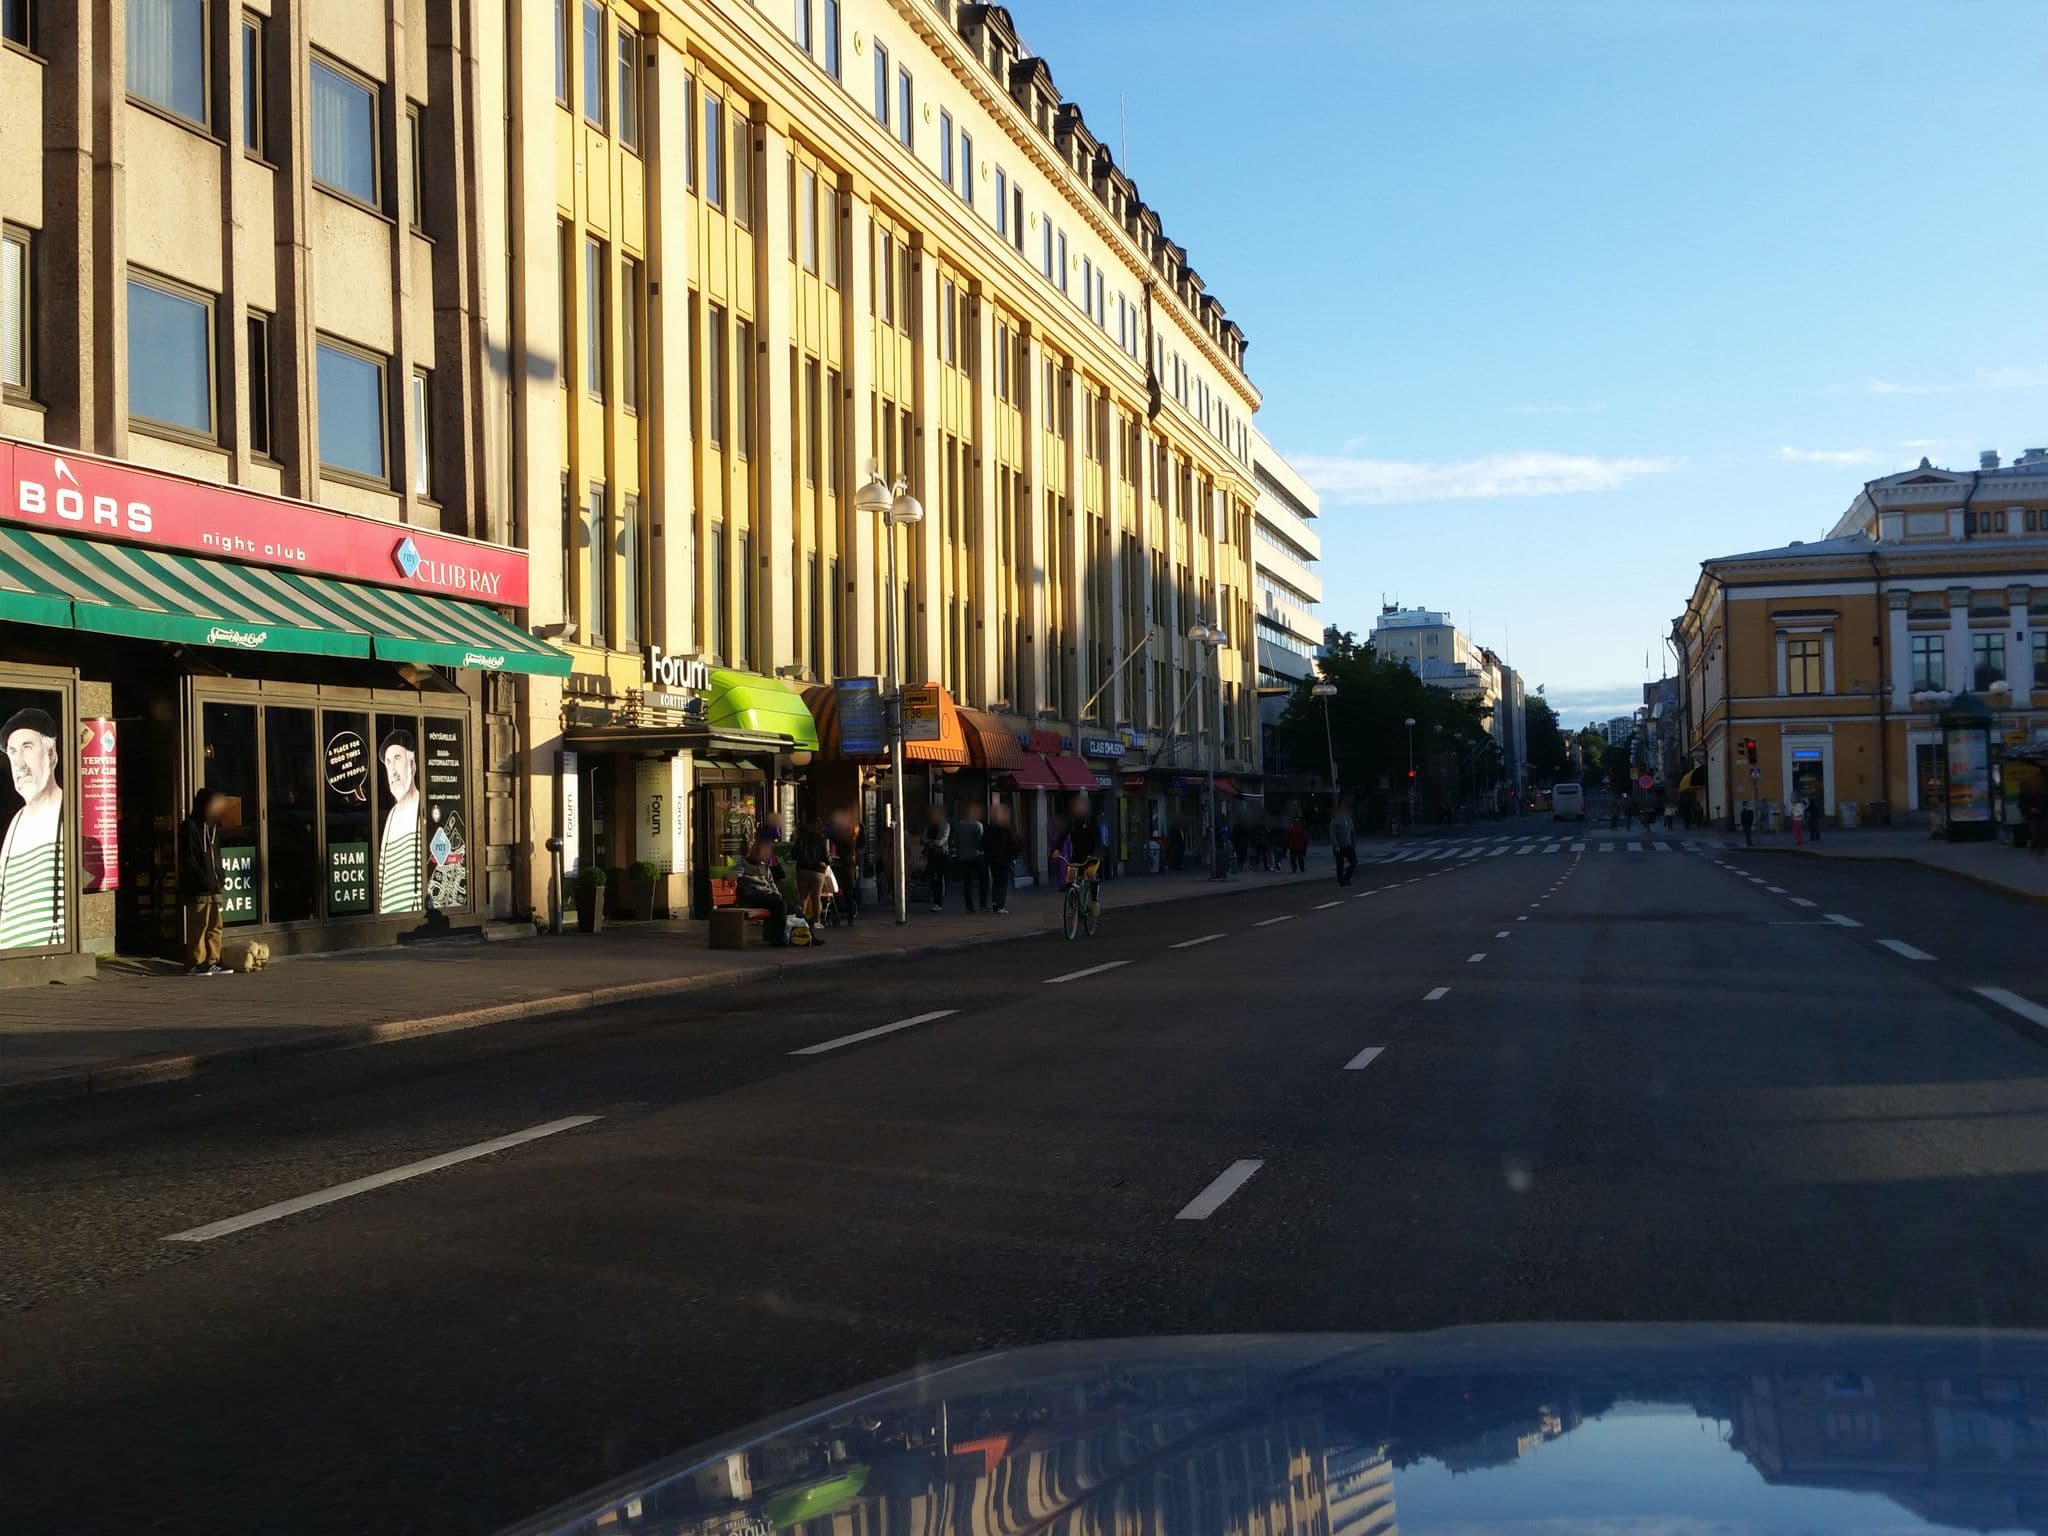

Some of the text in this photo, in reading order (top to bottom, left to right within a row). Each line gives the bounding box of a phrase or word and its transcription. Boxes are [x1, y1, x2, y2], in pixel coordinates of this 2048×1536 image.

[202, 531, 306, 561] night club
[416, 559, 500, 594] CLUB RAY
[651, 645, 712, 691] Forum.
[80, 767, 100, 776] RAY
[651, 794, 663, 838] Forum.
[221, 857, 251, 872] HAM
[333, 852, 365, 865] SHAM
[334, 869, 365, 883] ROCK
[334, 888, 366, 902] CAFE
